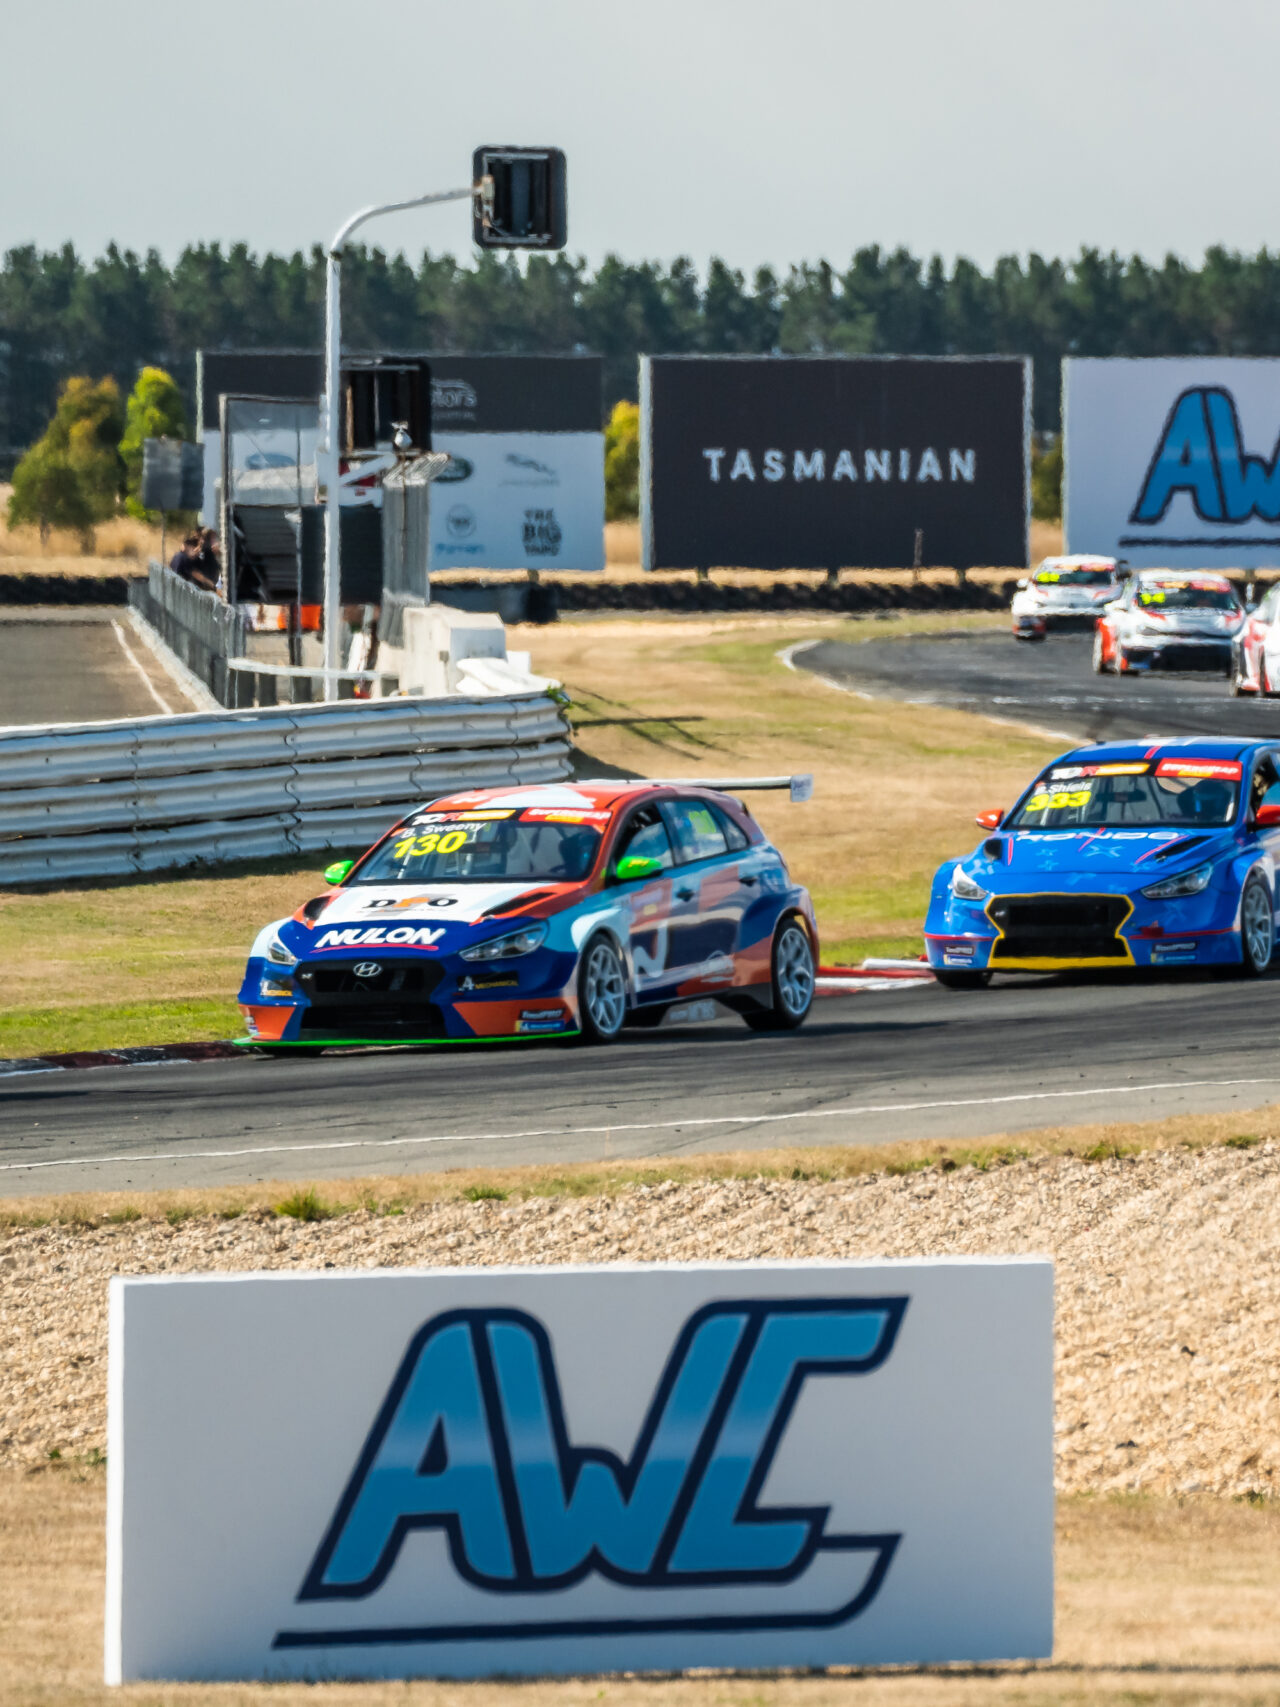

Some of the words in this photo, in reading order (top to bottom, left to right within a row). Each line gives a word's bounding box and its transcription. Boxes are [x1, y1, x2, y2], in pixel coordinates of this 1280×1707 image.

[702, 447, 976, 482] TASMANIAN
[1025, 790, 1092, 812] 333
[421, 822, 488, 835] Sweeny
[394, 831, 467, 858] 130
[314, 927, 447, 948] NULON
[280, 1296, 911, 1625] AWC
